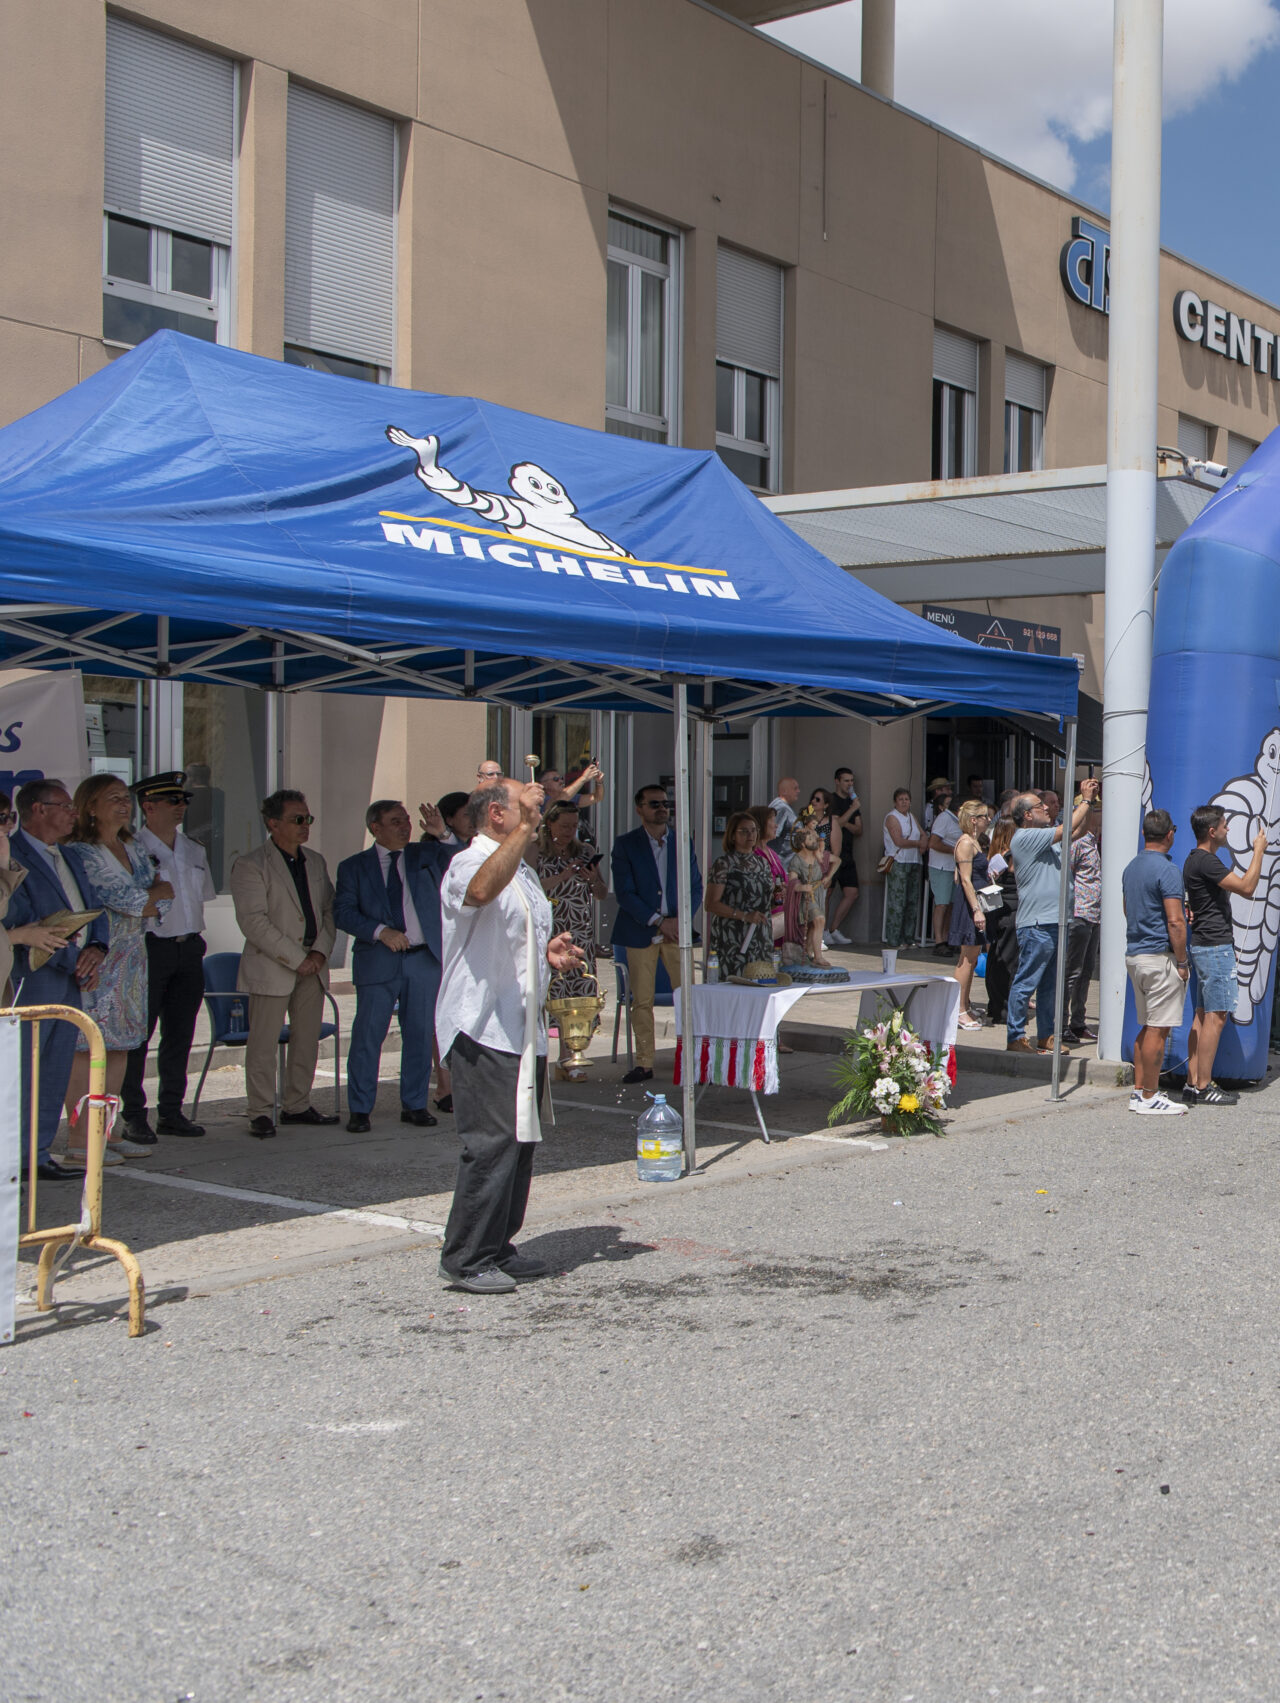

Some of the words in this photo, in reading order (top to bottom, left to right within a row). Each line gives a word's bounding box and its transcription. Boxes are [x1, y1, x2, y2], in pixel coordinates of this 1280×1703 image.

[1060, 216, 1110, 314] CT
[380, 522, 741, 601] MICHELIN
[927, 611, 955, 625] MENÚ
